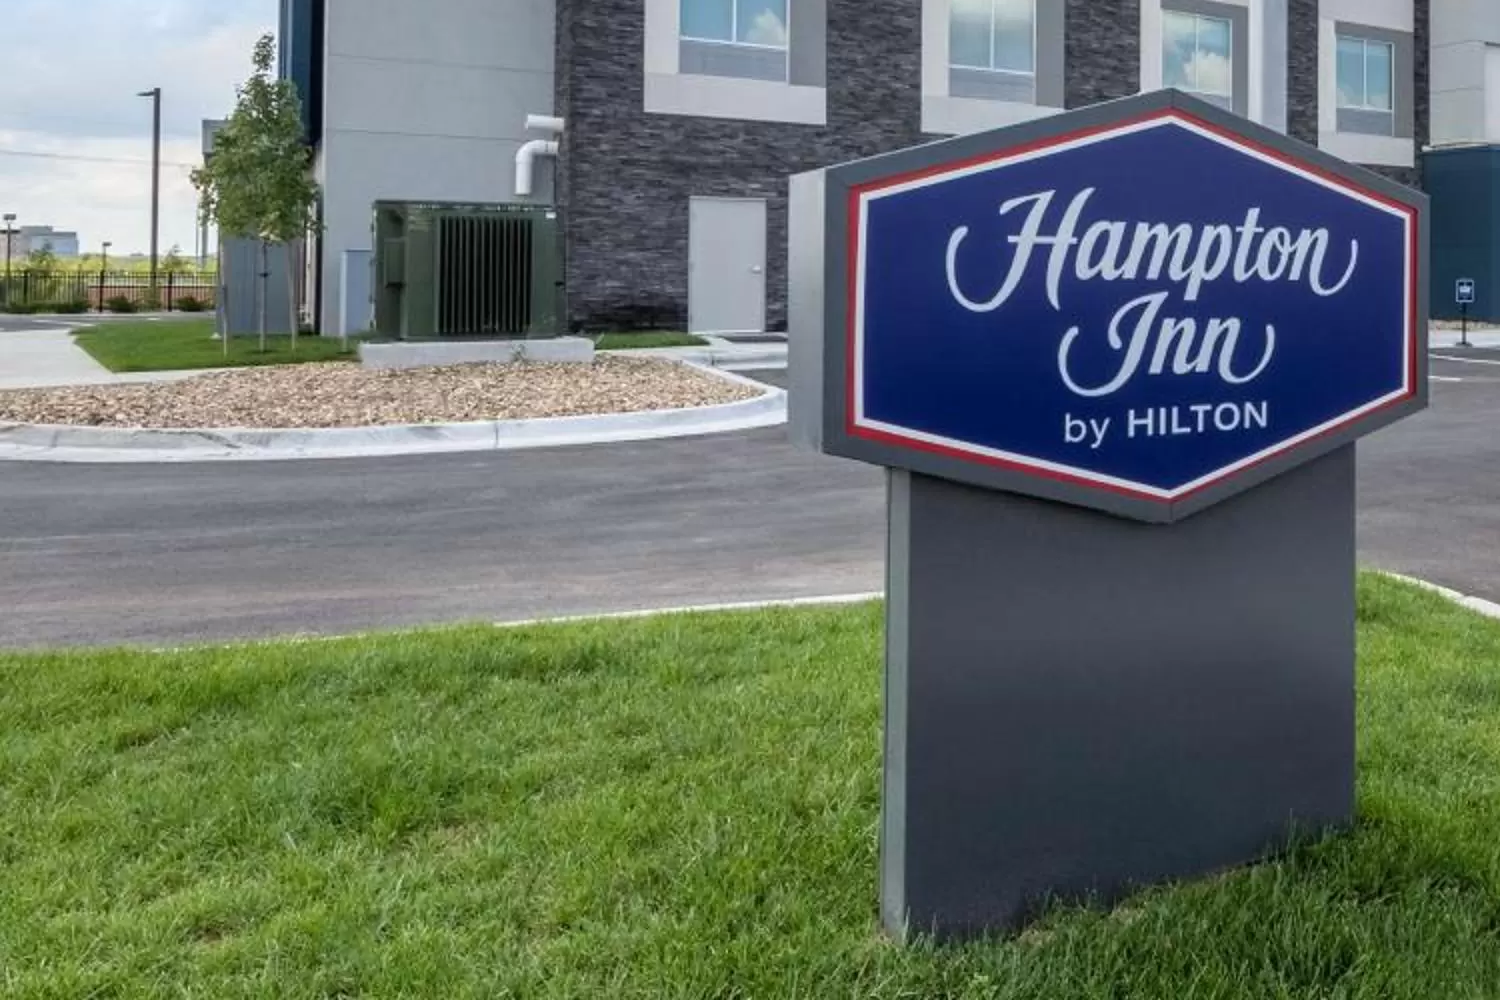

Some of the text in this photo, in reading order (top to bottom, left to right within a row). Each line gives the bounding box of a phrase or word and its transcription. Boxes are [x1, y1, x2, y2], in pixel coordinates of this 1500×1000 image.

[946, 187, 1358, 312] Hampton
[1058, 292, 1276, 397] Inn
[1065, 401, 1269, 449] by HILTON
